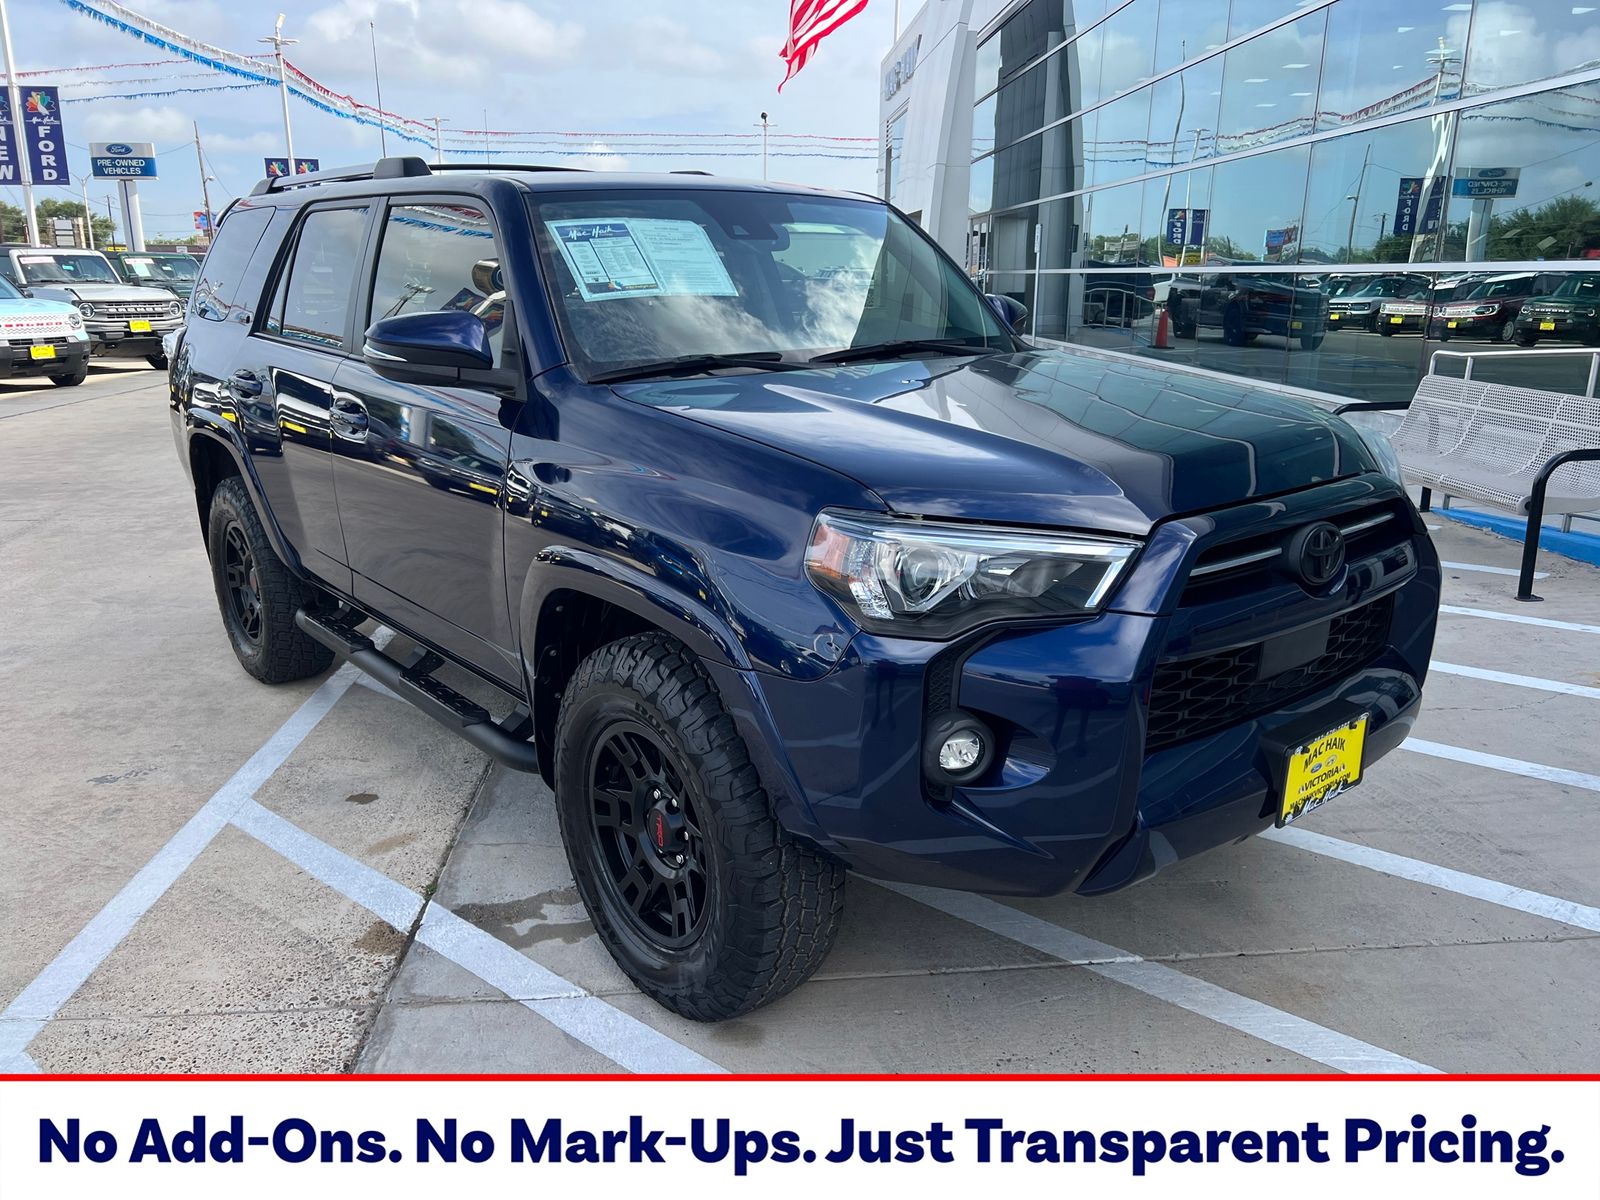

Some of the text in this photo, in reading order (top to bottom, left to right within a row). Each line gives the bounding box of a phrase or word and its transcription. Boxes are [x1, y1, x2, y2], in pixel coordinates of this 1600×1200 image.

[38, 126, 57, 180] FORD
[103, 167, 141, 175] VEHICLES
[568, 230, 590, 241] Mac
[592, 225, 616, 238] Haik
[1303, 743, 1324, 772] MAC
[1326, 736, 1345, 752] HAIK
[1304, 766, 1340, 792] VICTORIA
[1301, 797, 1321, 816] Mac
